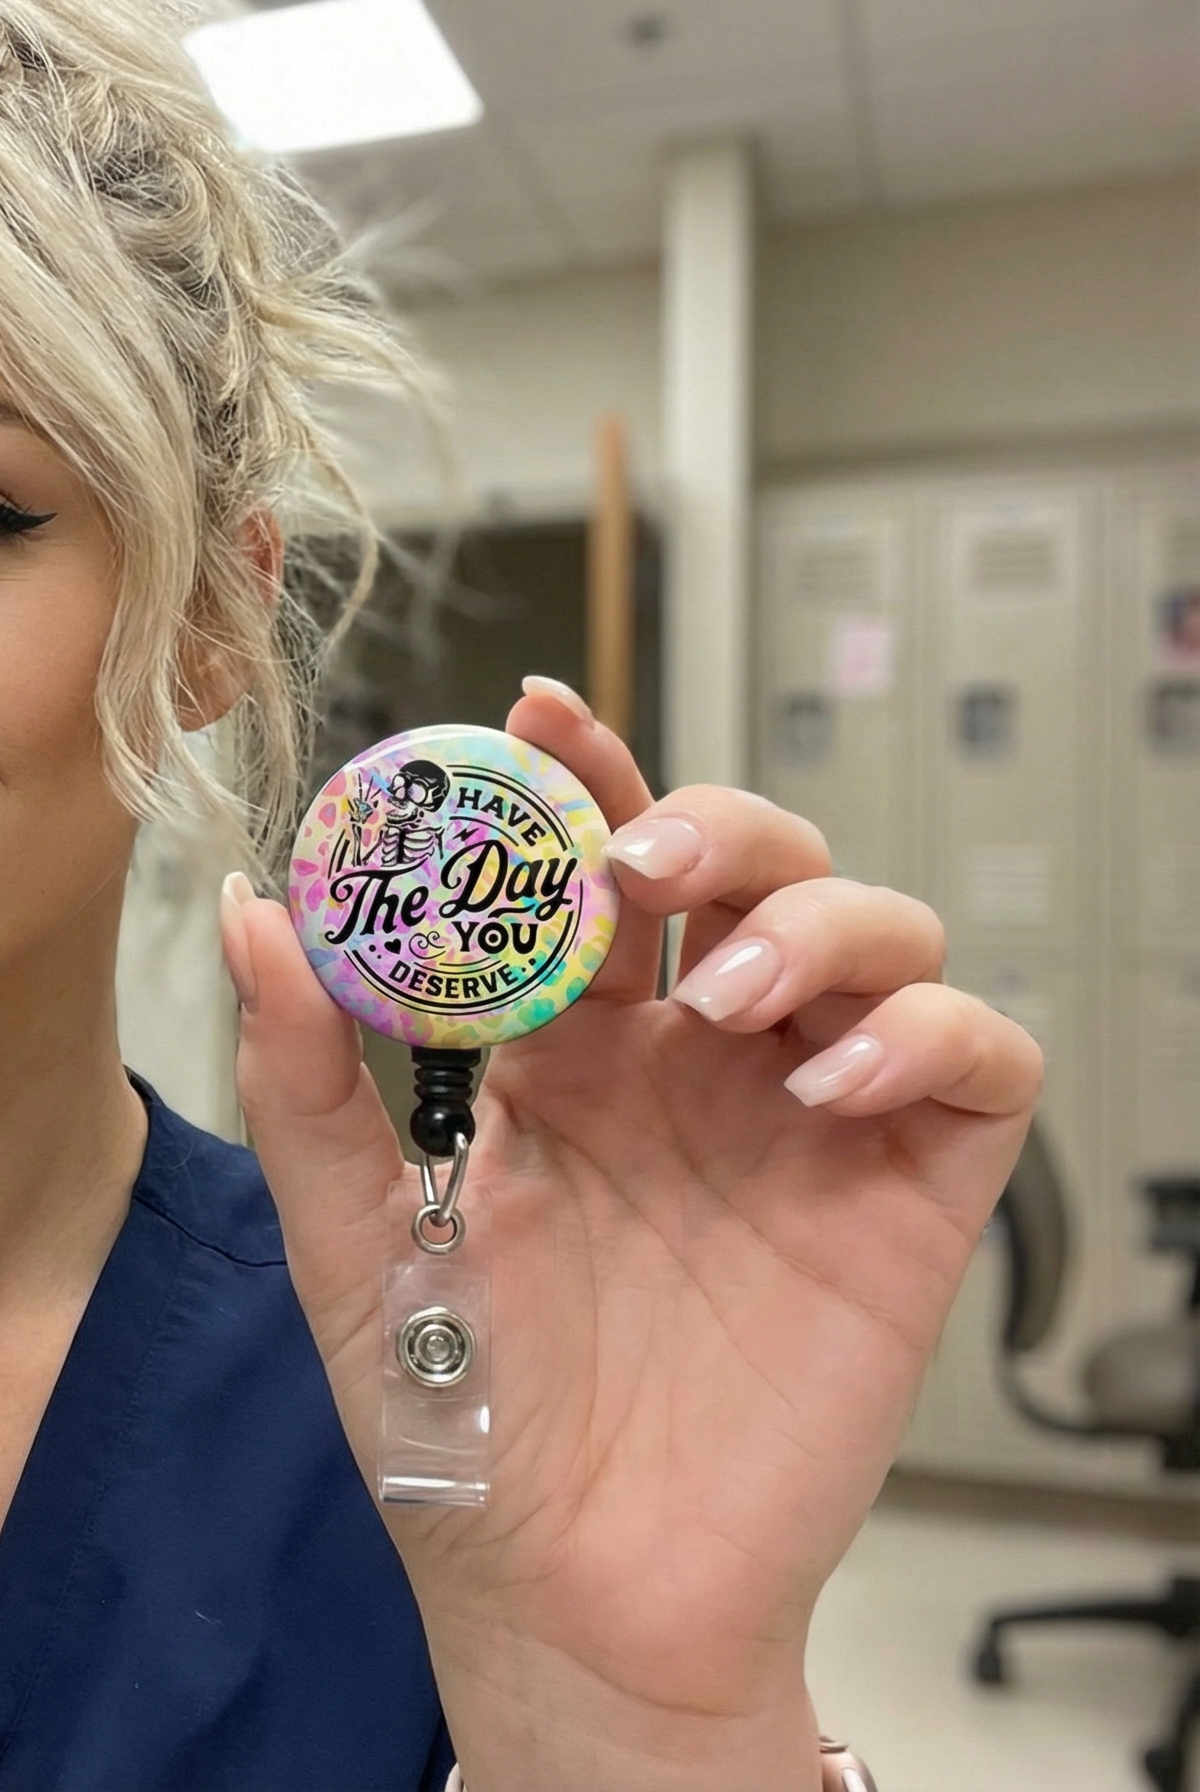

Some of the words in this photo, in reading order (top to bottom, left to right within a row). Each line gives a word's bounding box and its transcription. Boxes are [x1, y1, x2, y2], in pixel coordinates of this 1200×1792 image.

[457, 787, 547, 847] HAVE
[325, 858, 429, 944] The
[439, 839, 577, 921] Day
[452, 921, 538, 954] YOU
[388, 960, 518, 998] DESERVE
